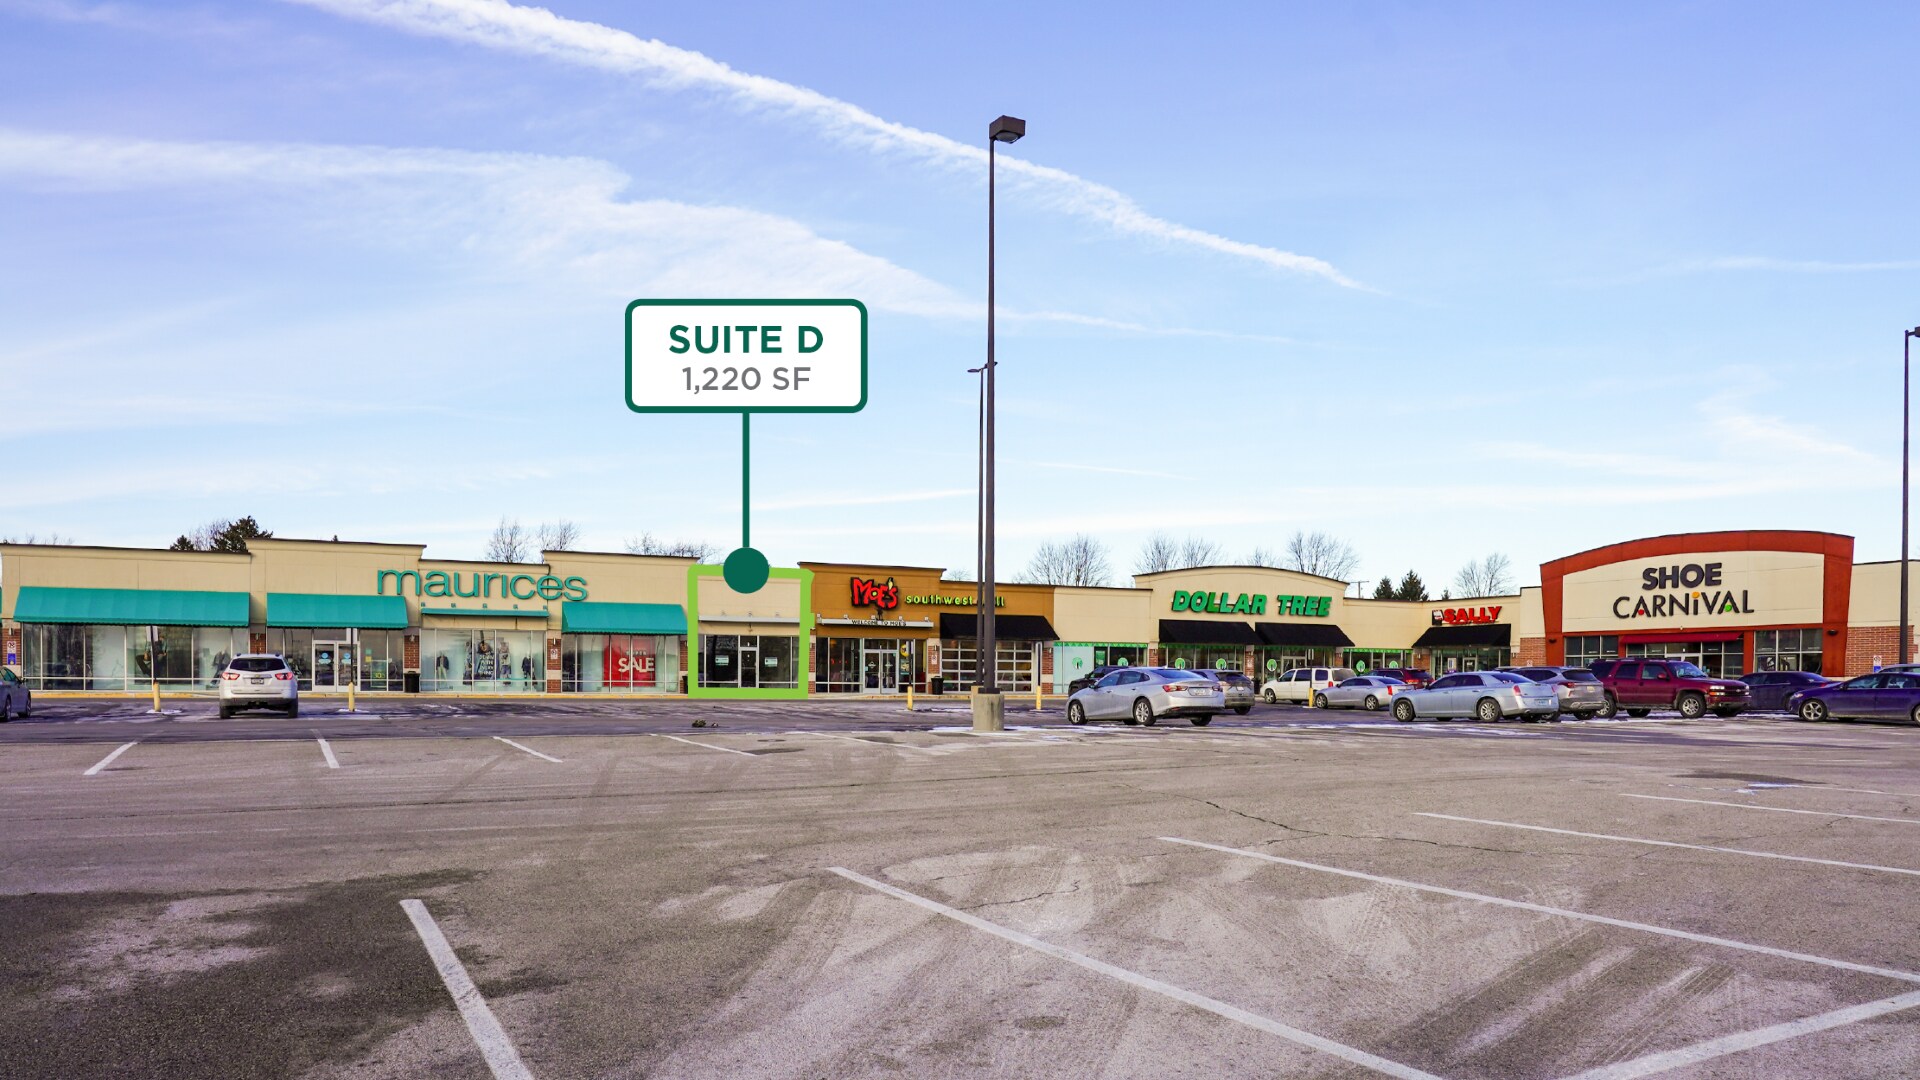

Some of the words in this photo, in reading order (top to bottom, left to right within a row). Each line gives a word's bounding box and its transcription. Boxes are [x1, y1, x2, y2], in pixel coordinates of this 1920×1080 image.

[377, 569, 588, 601] maurices
[1641, 562, 1722, 590] SHOE
[906, 594, 973, 606] southwest
[1172, 590, 1268, 615] DOLLAR
[1277, 594, 1333, 617] TREE
[1443, 606, 1503, 622] SALLY
[618, 656, 654, 673] SALE
